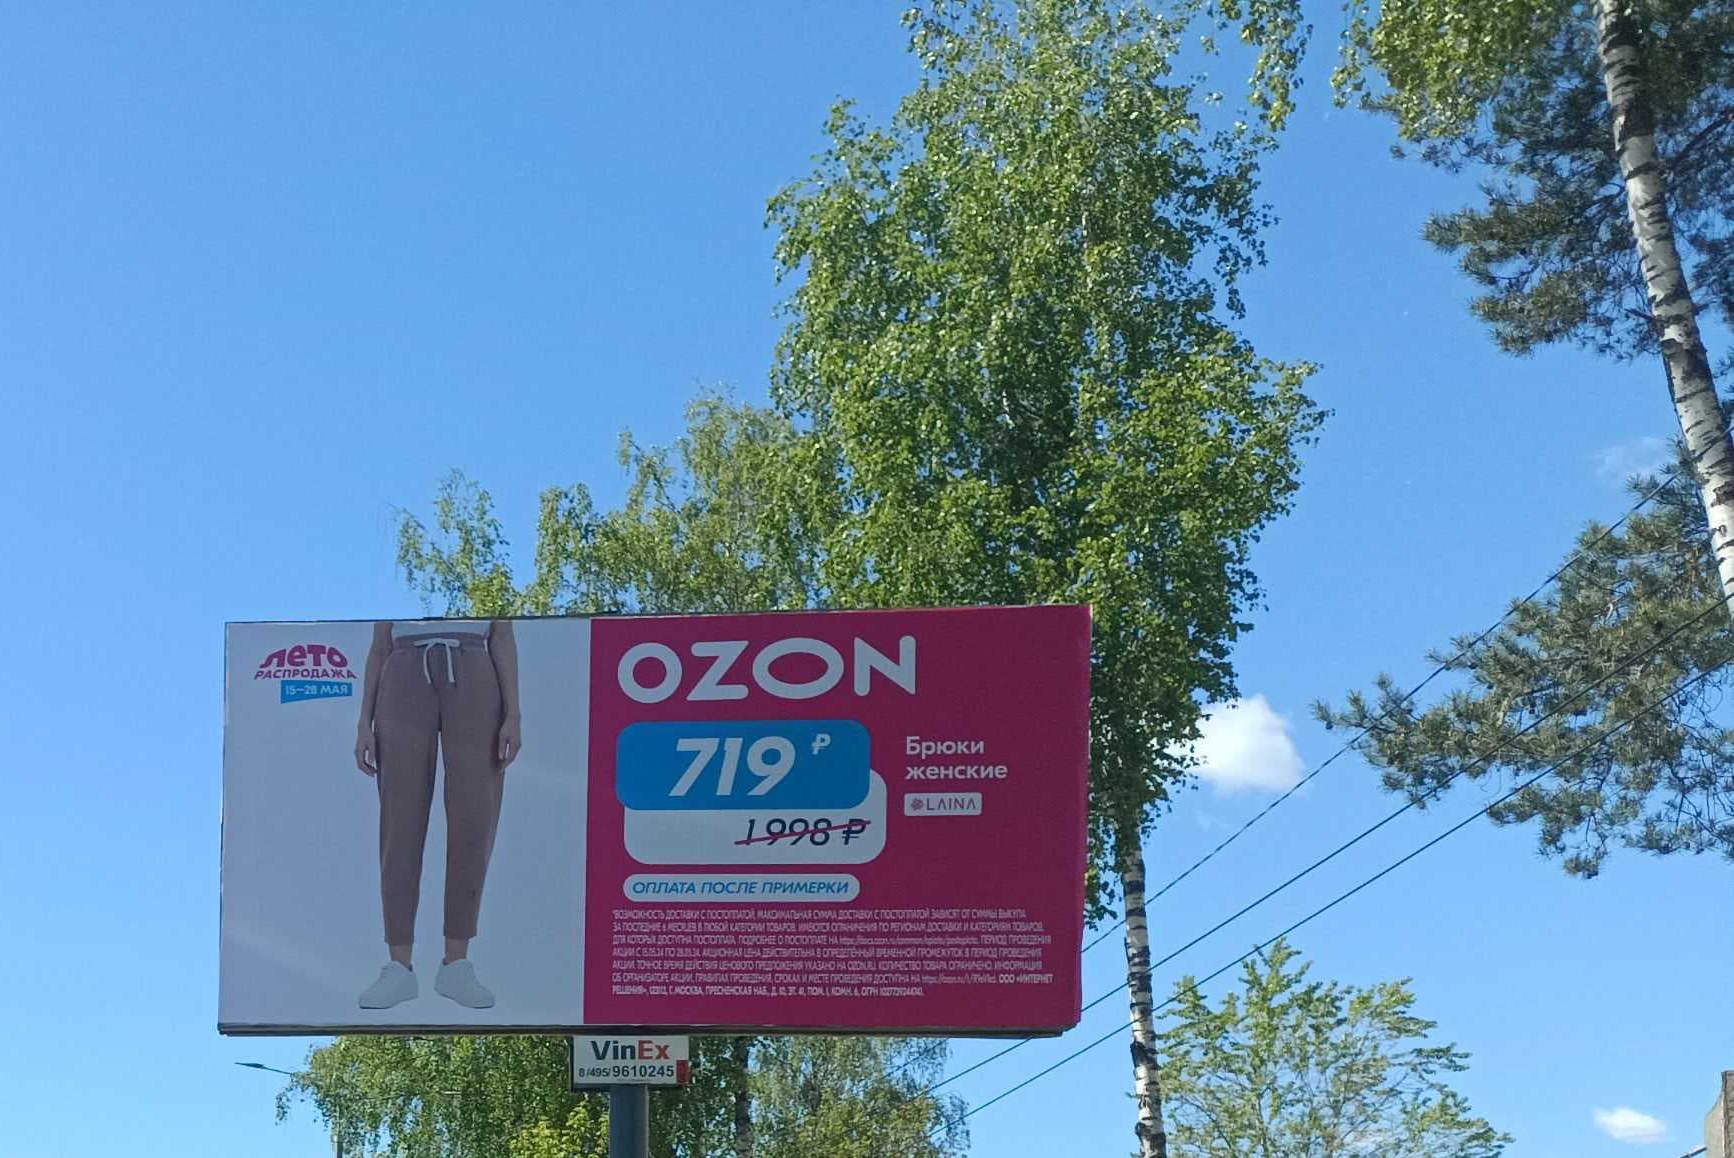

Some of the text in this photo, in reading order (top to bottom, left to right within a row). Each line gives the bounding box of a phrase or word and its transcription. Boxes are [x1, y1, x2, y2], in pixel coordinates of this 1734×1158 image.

[254, 668, 358, 680] РАСПРОДАЖА
[617, 635, 916, 703] OZON
[320, 684, 348, 695] МАЯ
[905, 735, 985, 760] Брюки
[668, 733, 831, 797] 719 ₽
[905, 763, 1008, 781] женские
[632, 880, 850, 894] ОПЛАТА ПОСЛЕ ПРИМЕРКИ
[590, 1040, 670, 1060] VinEx
